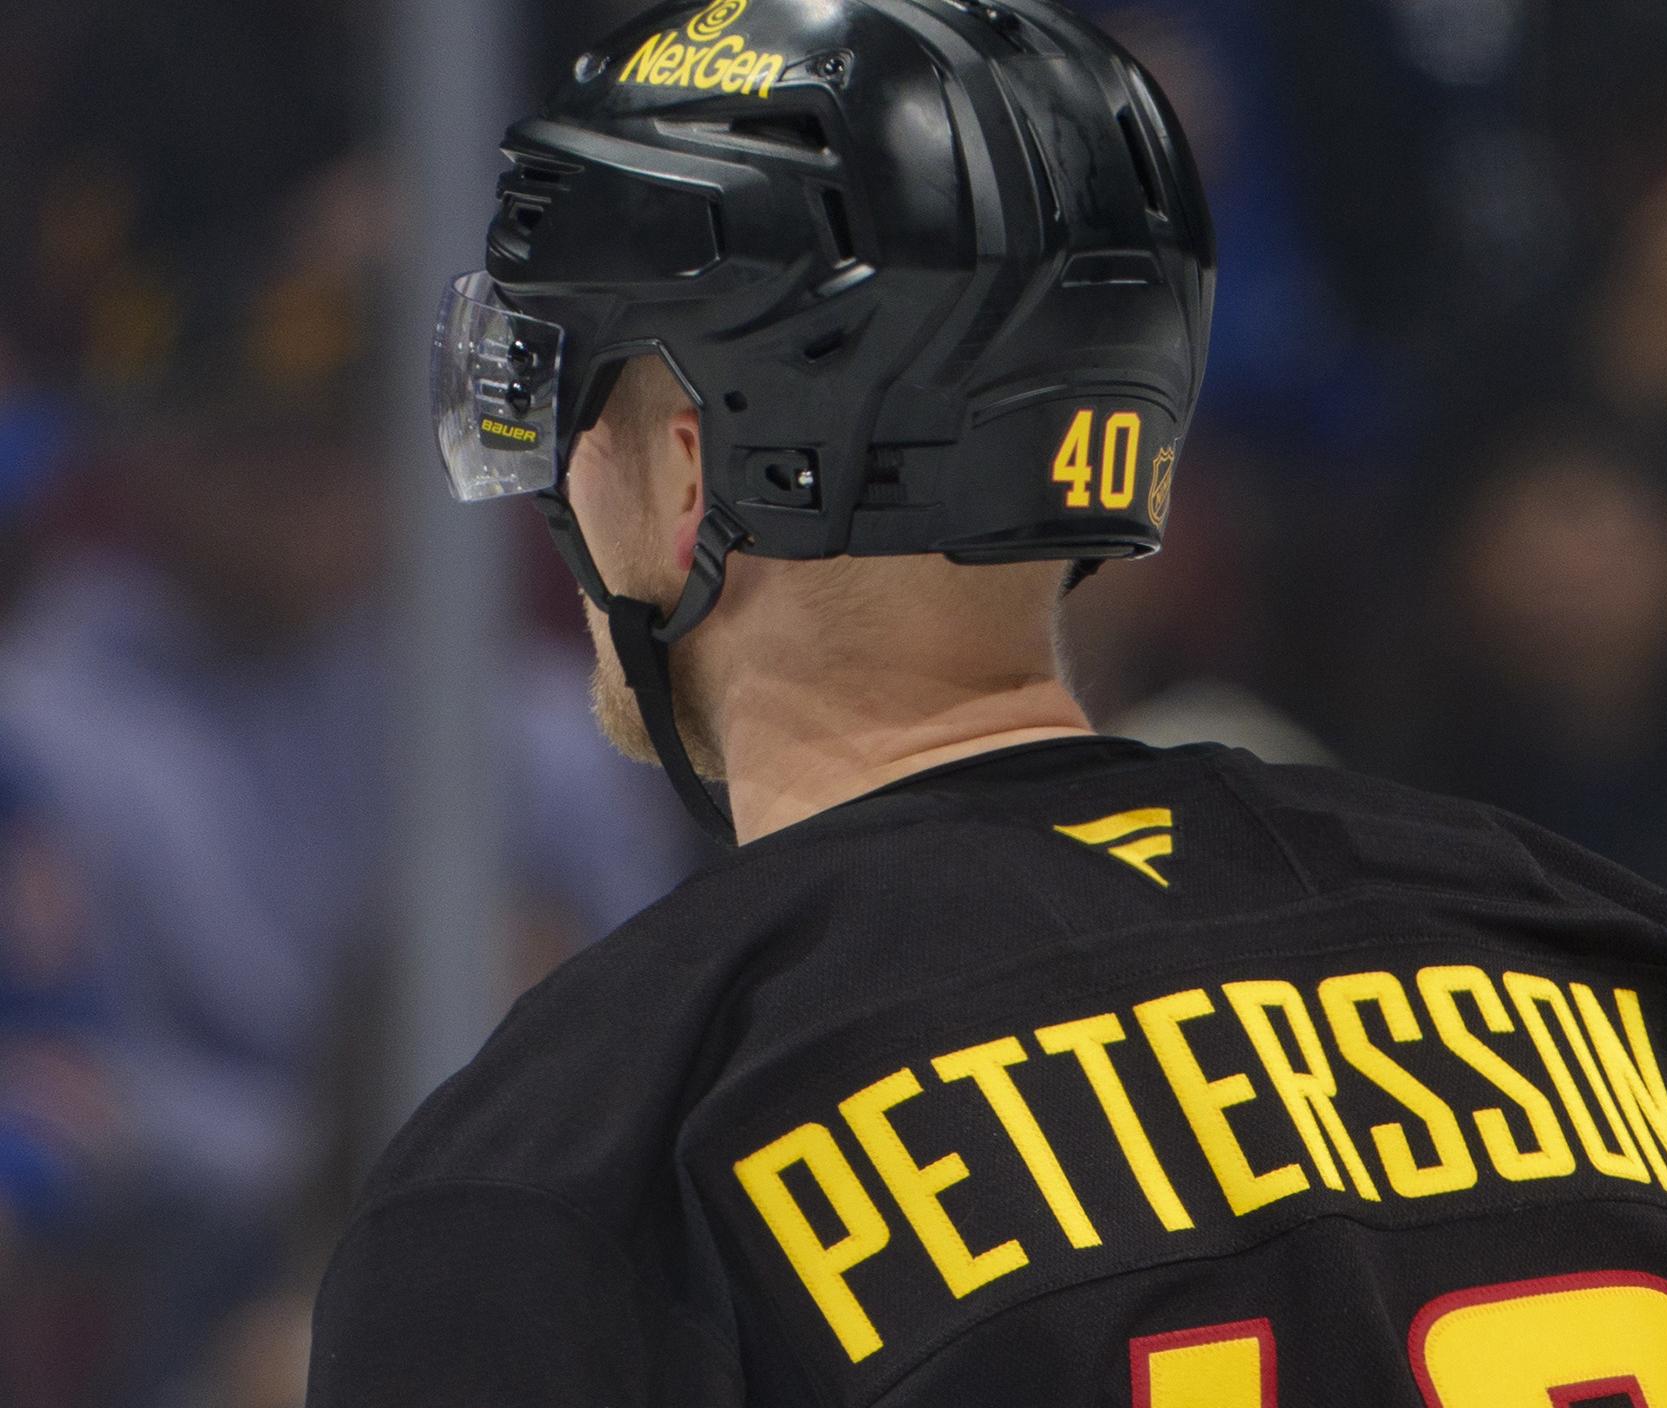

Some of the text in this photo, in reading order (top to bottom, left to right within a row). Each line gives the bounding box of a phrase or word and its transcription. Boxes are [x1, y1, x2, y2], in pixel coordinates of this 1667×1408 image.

[618, 31, 784, 99] NexGen
[481, 418, 537, 442] BAUER
[1052, 408, 1142, 510] 40
